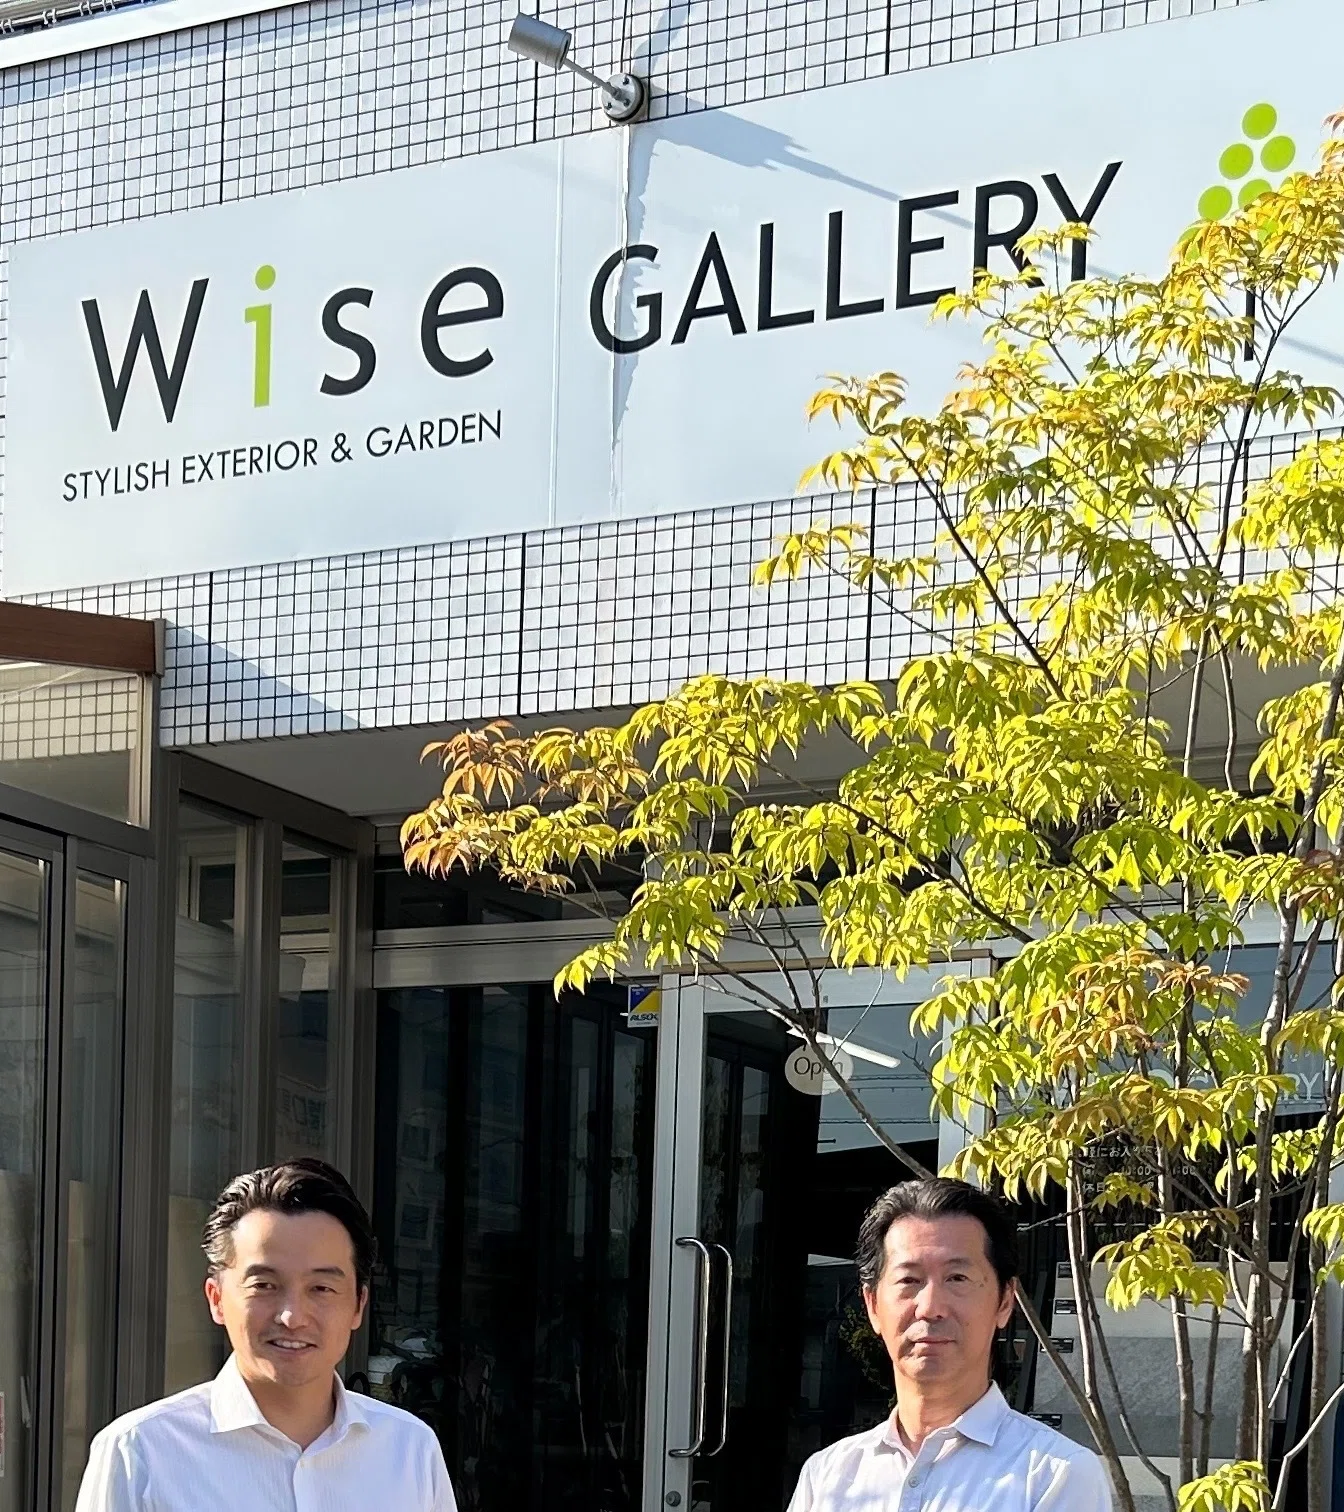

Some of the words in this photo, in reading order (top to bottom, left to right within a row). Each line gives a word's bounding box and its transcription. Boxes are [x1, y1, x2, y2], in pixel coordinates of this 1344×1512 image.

[81, 264, 505, 433] Wise
[589, 160, 1124, 355] GALLERY
[62, 458, 170, 503] STYLISH
[182, 438, 318, 485] EXTERIOR
[330, 432, 353, 463] &
[366, 409, 502, 458] GARDEN
